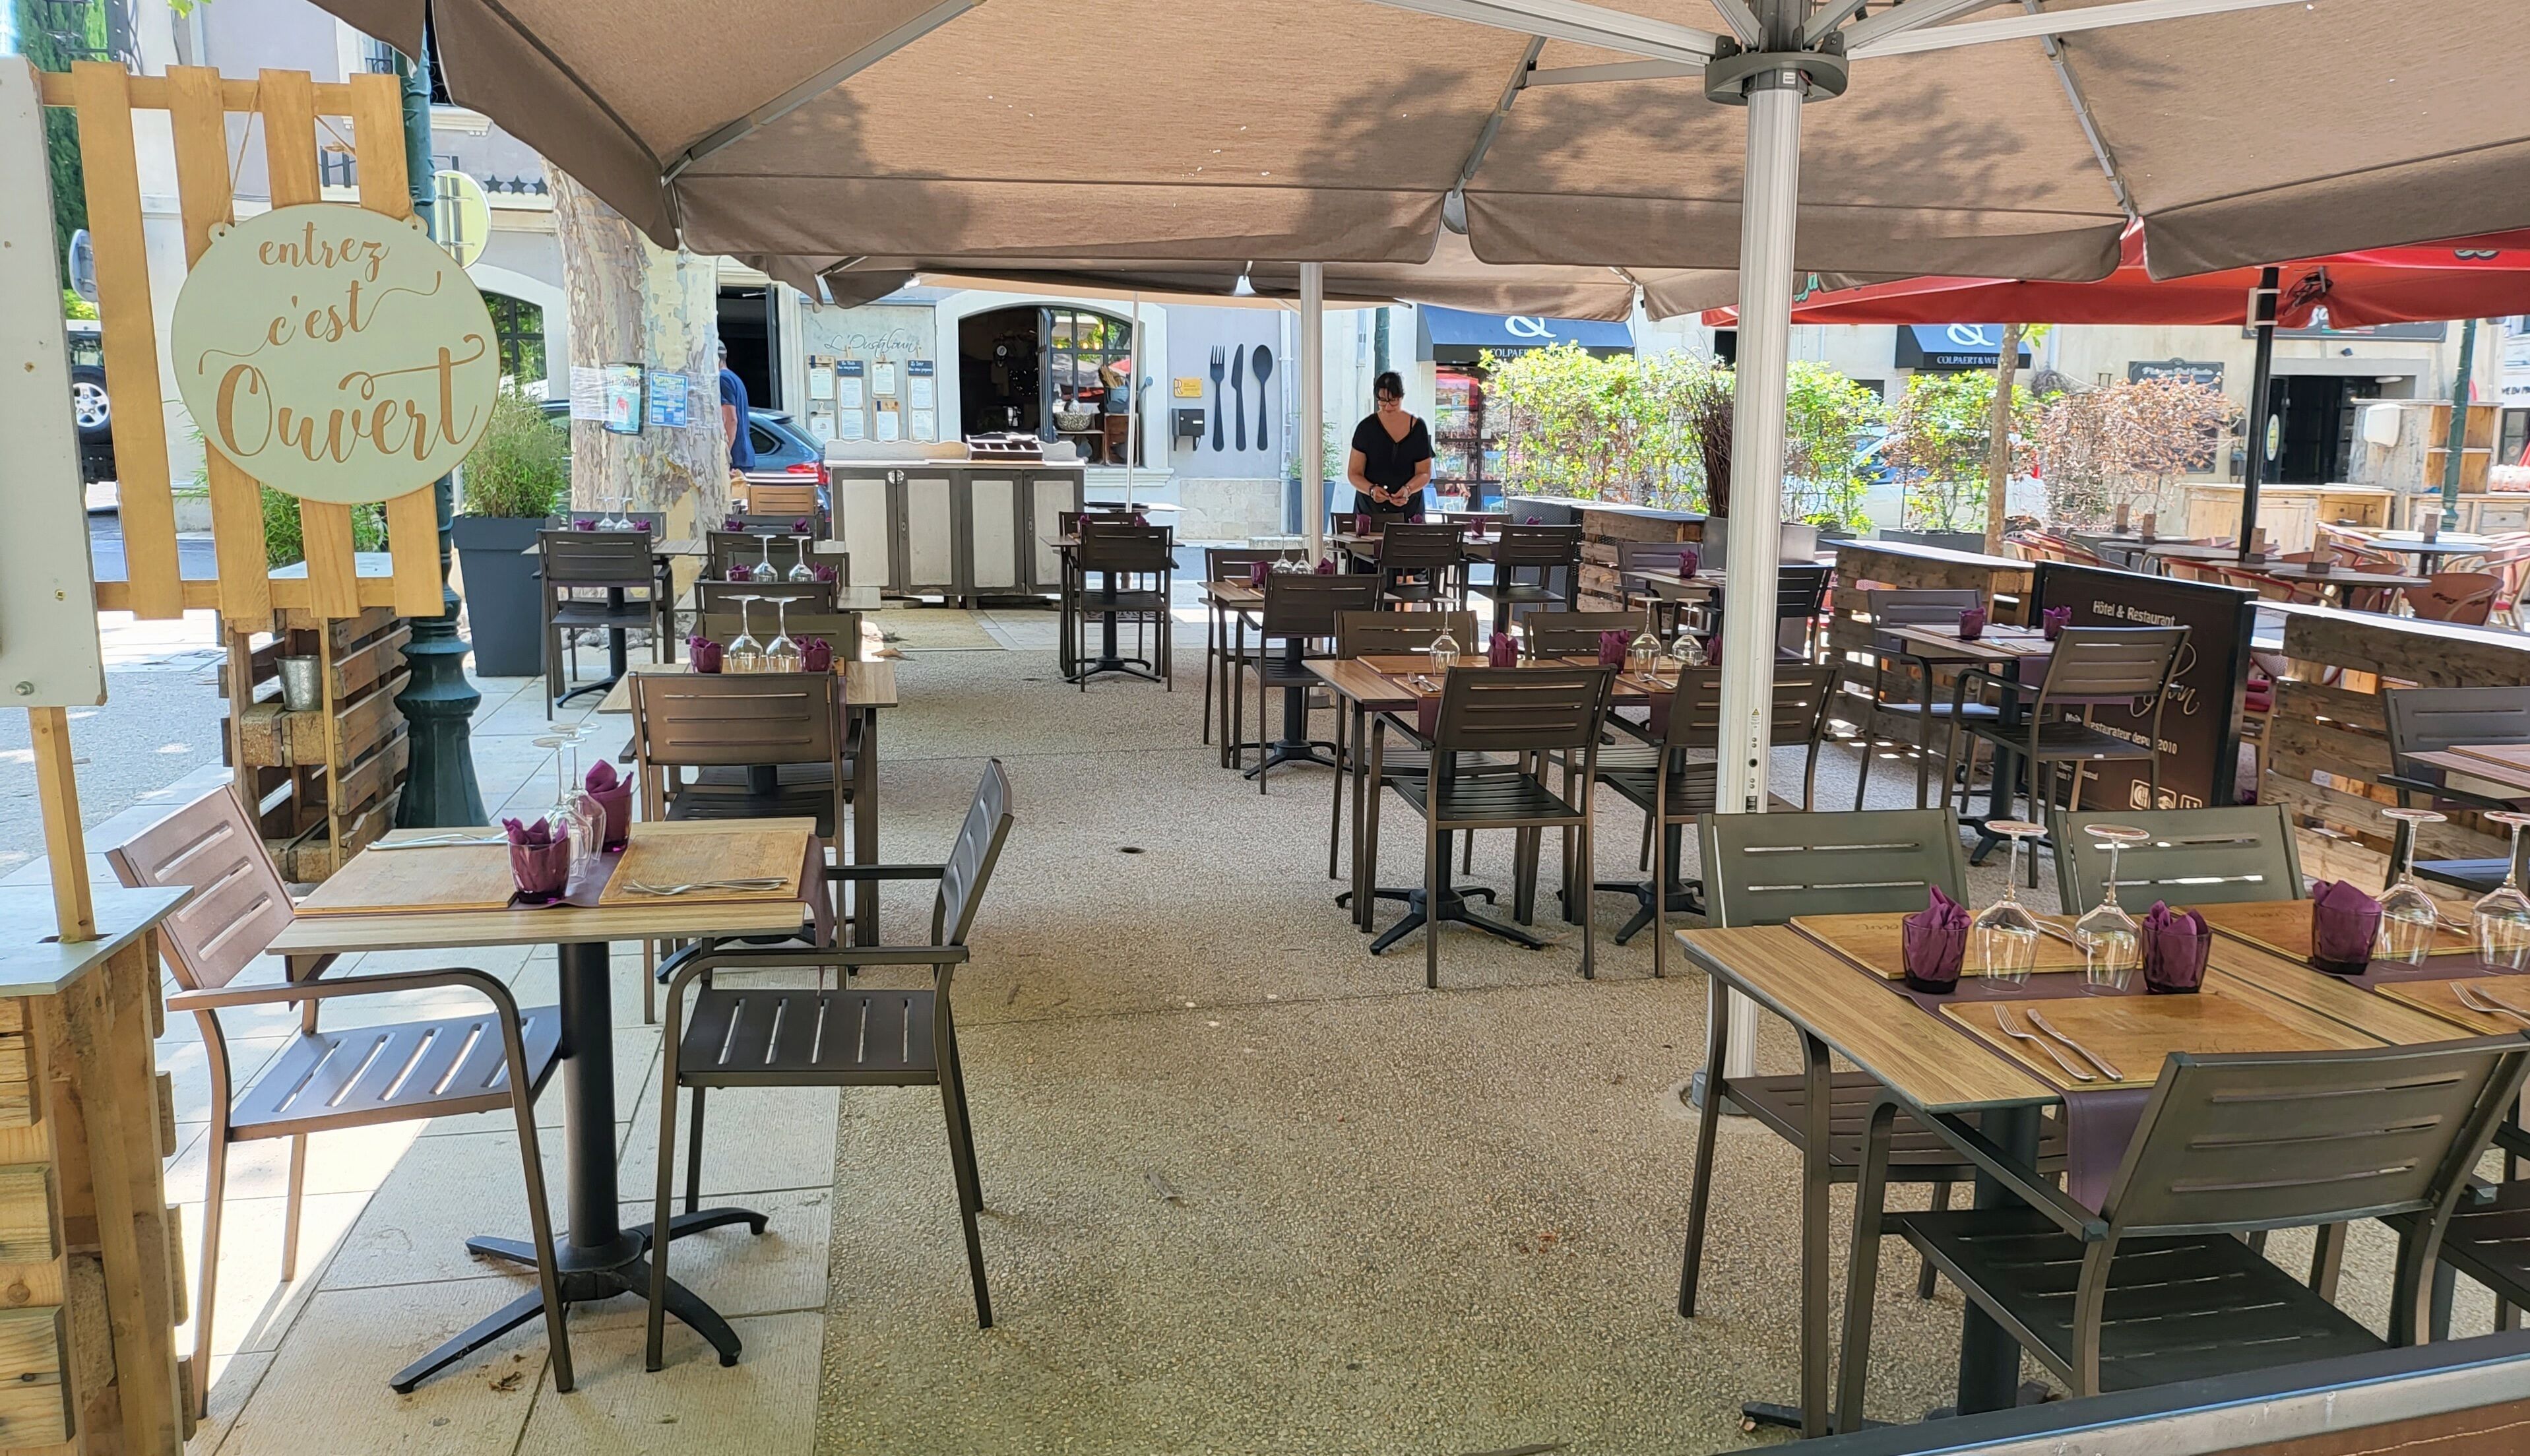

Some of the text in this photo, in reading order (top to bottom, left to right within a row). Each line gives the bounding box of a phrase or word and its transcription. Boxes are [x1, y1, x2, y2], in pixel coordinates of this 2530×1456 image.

[259, 221, 391, 282] entrez
[216, 334, 486, 464] Ouvert
[2093, 600, 2176, 627] Hôtel & Restaurant
[2090, 722, 2132, 742] estaurateur
[2132, 732, 2151, 747] depu
[2157, 739, 2178, 755] 2010
